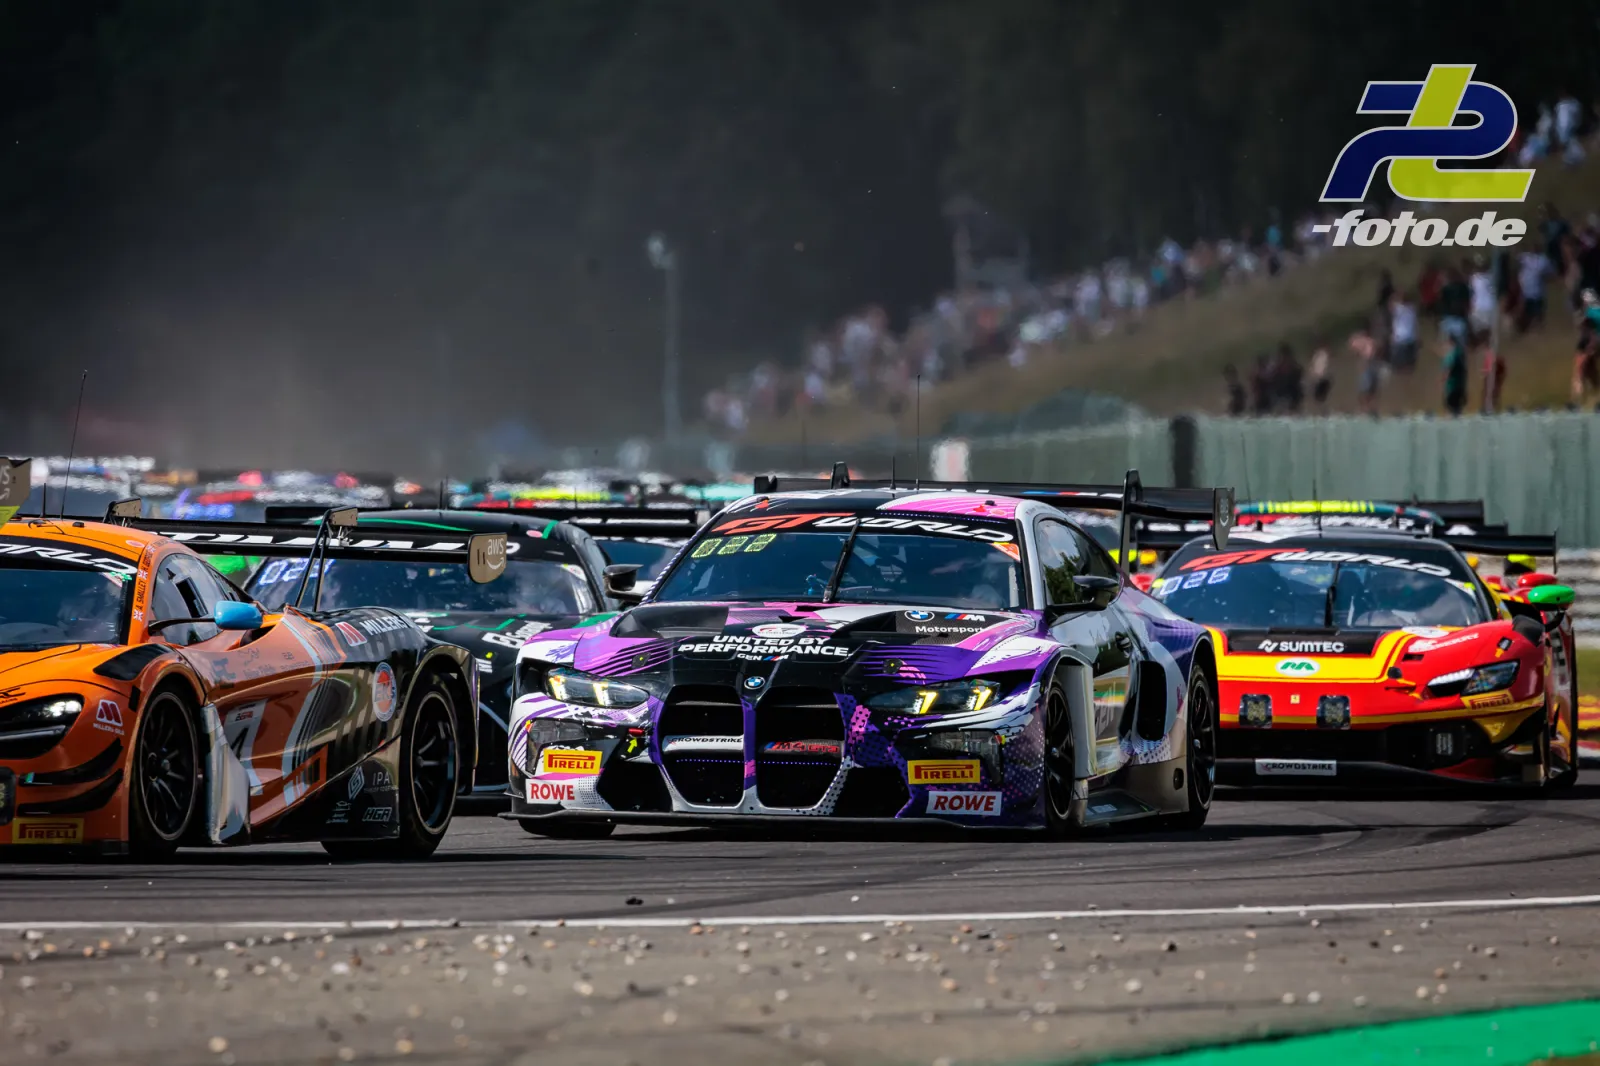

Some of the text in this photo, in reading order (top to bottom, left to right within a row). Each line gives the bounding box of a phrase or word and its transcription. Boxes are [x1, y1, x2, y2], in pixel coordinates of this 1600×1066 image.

[711, 512, 1013, 542] GT WORLD
[487, 538, 504, 555] aws
[691, 533, 777, 558] 022
[1179, 548, 1451, 577] GT WORLD
[1160, 566, 1232, 595] 026
[915, 625, 984, 633] Motorsport
[713, 635, 831, 646] UNITED BY
[1280, 641, 1345, 653] SUMTEC
[737, 653, 762, 661] GEN
[548, 754, 596, 770] PIRELLI
[1265, 762, 1333, 771] CROWDSTRIKE
[914, 764, 974, 780] PIRELLI
[530, 782, 576, 800] ROWE
[933, 795, 997, 812] ROWE
[19, 822, 77, 839] PIRELLI
